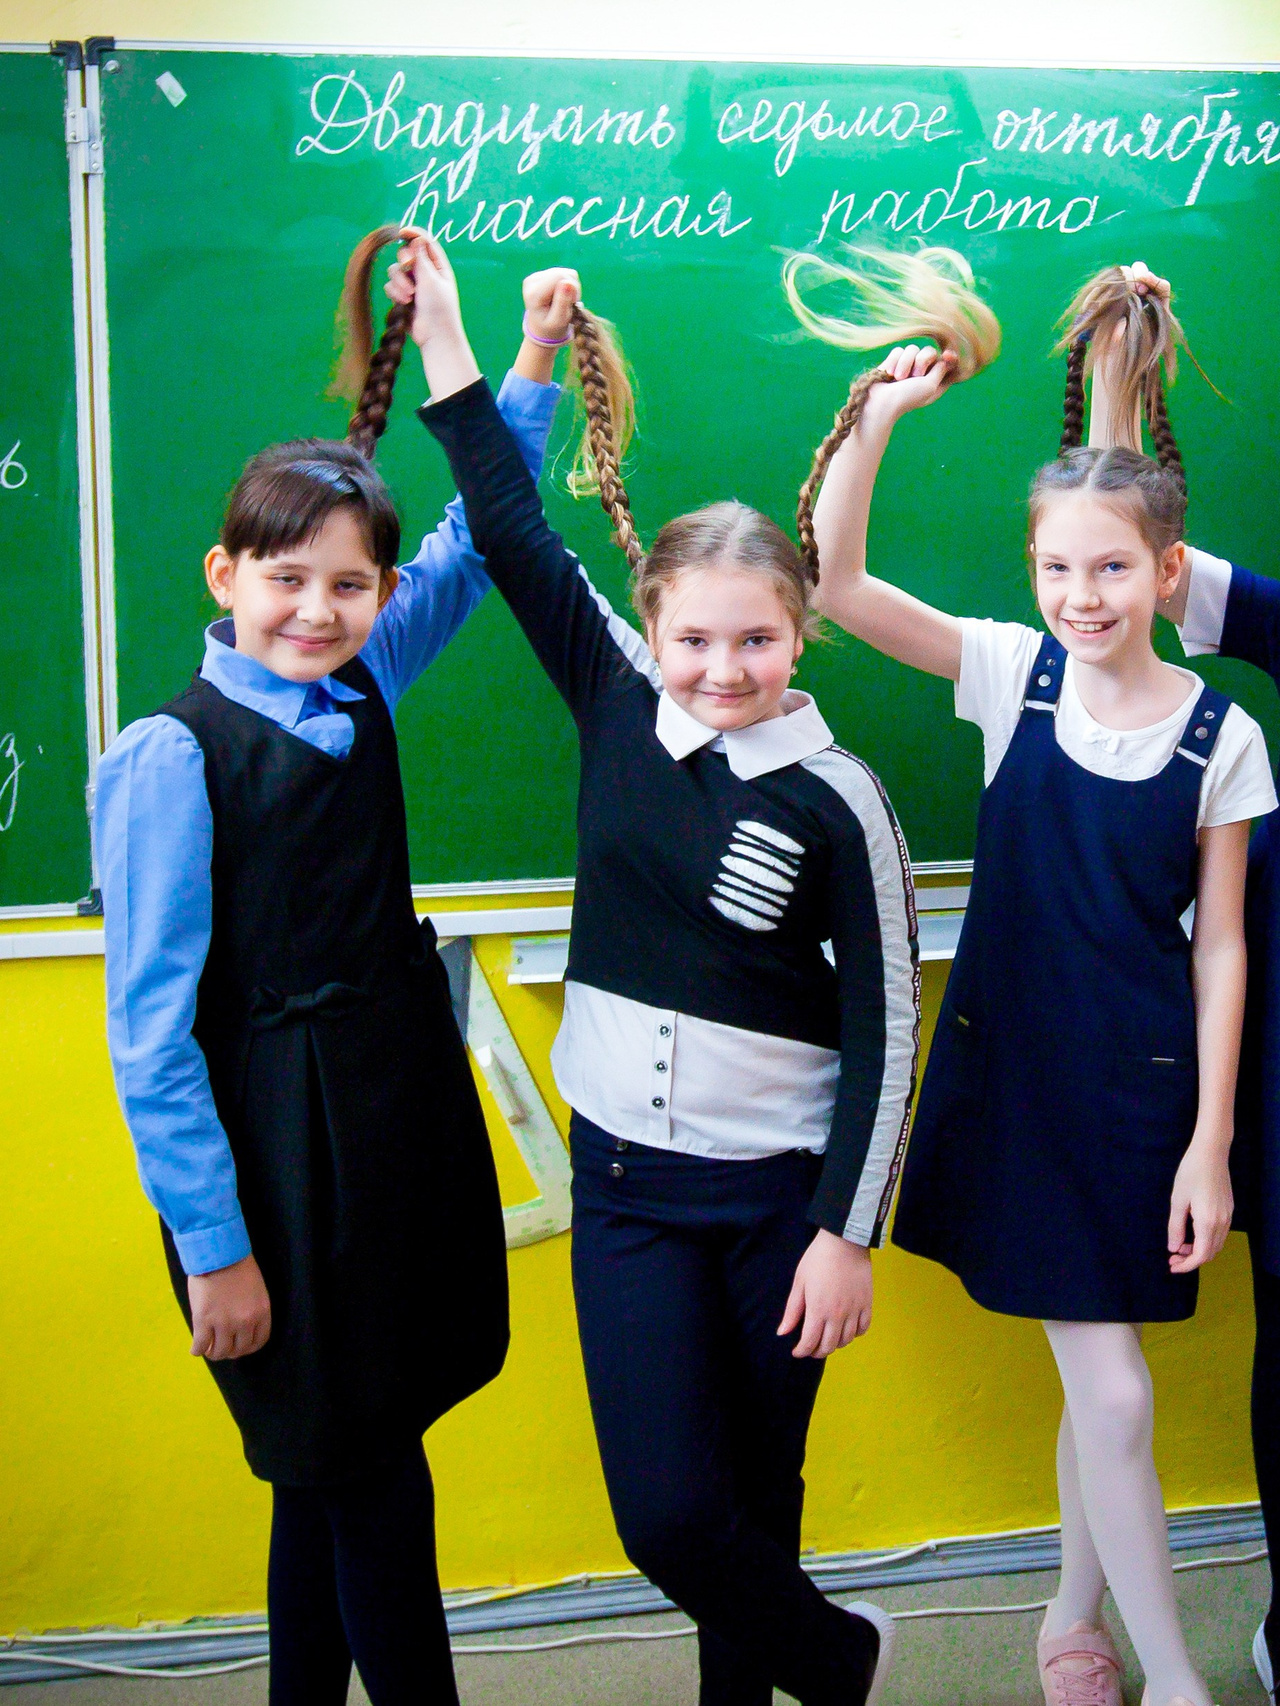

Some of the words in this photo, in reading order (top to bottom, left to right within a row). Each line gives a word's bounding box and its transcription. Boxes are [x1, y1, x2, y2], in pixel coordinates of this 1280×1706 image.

[296, 70, 676, 204] Двадцать
[717, 98, 957, 178] седьмое
[396, 156, 753, 244] Классная
[817, 157, 1127, 244] работа
